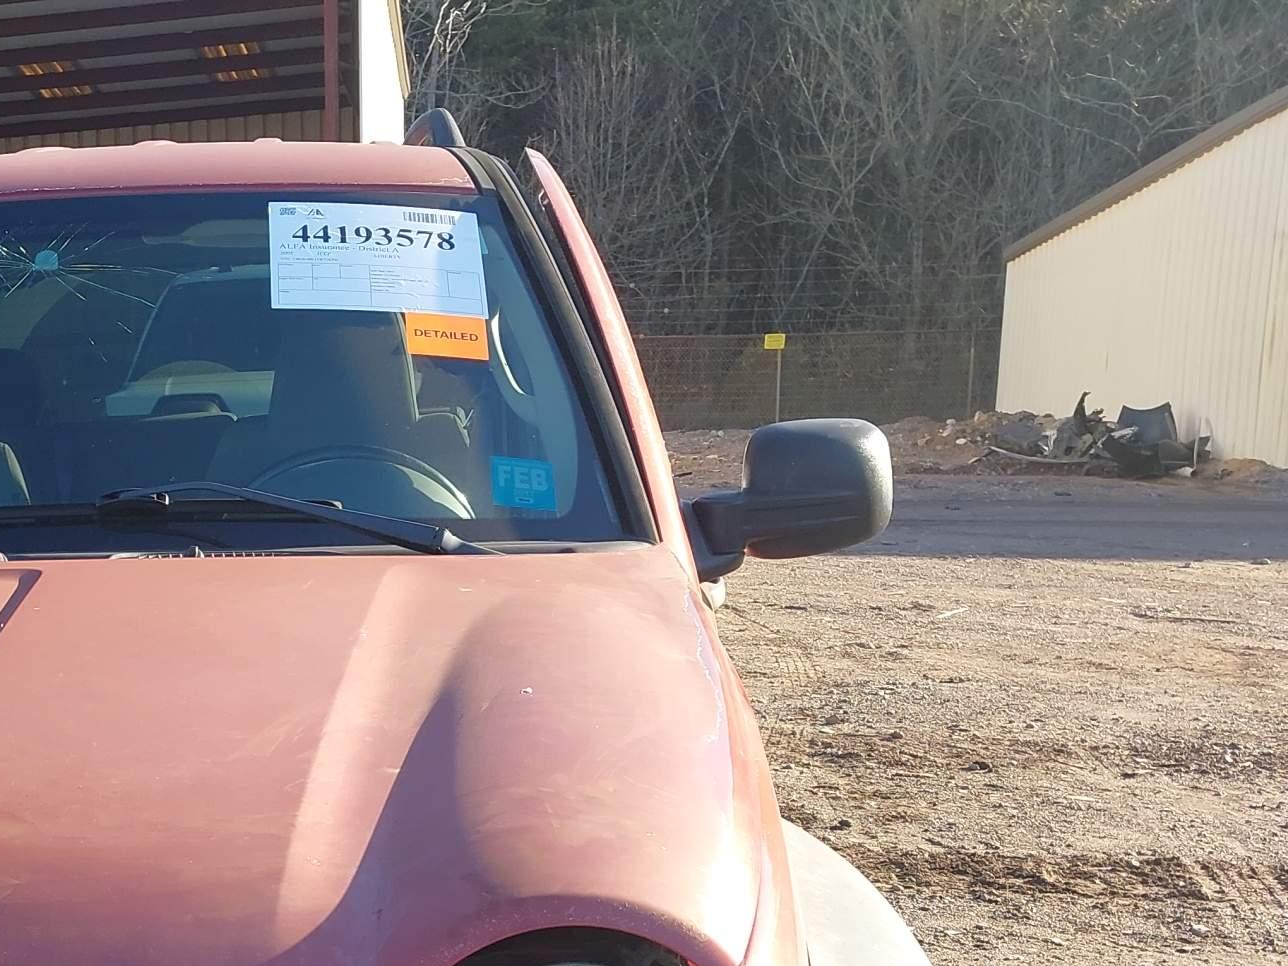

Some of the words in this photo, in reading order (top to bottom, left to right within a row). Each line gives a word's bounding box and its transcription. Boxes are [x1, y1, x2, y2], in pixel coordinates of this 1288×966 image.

[292, 224, 456, 250] 44193578
[309, 243, 350, 251] Insurance
[413, 328, 479, 342] DETAILED
[496, 464, 549, 492] FEB
